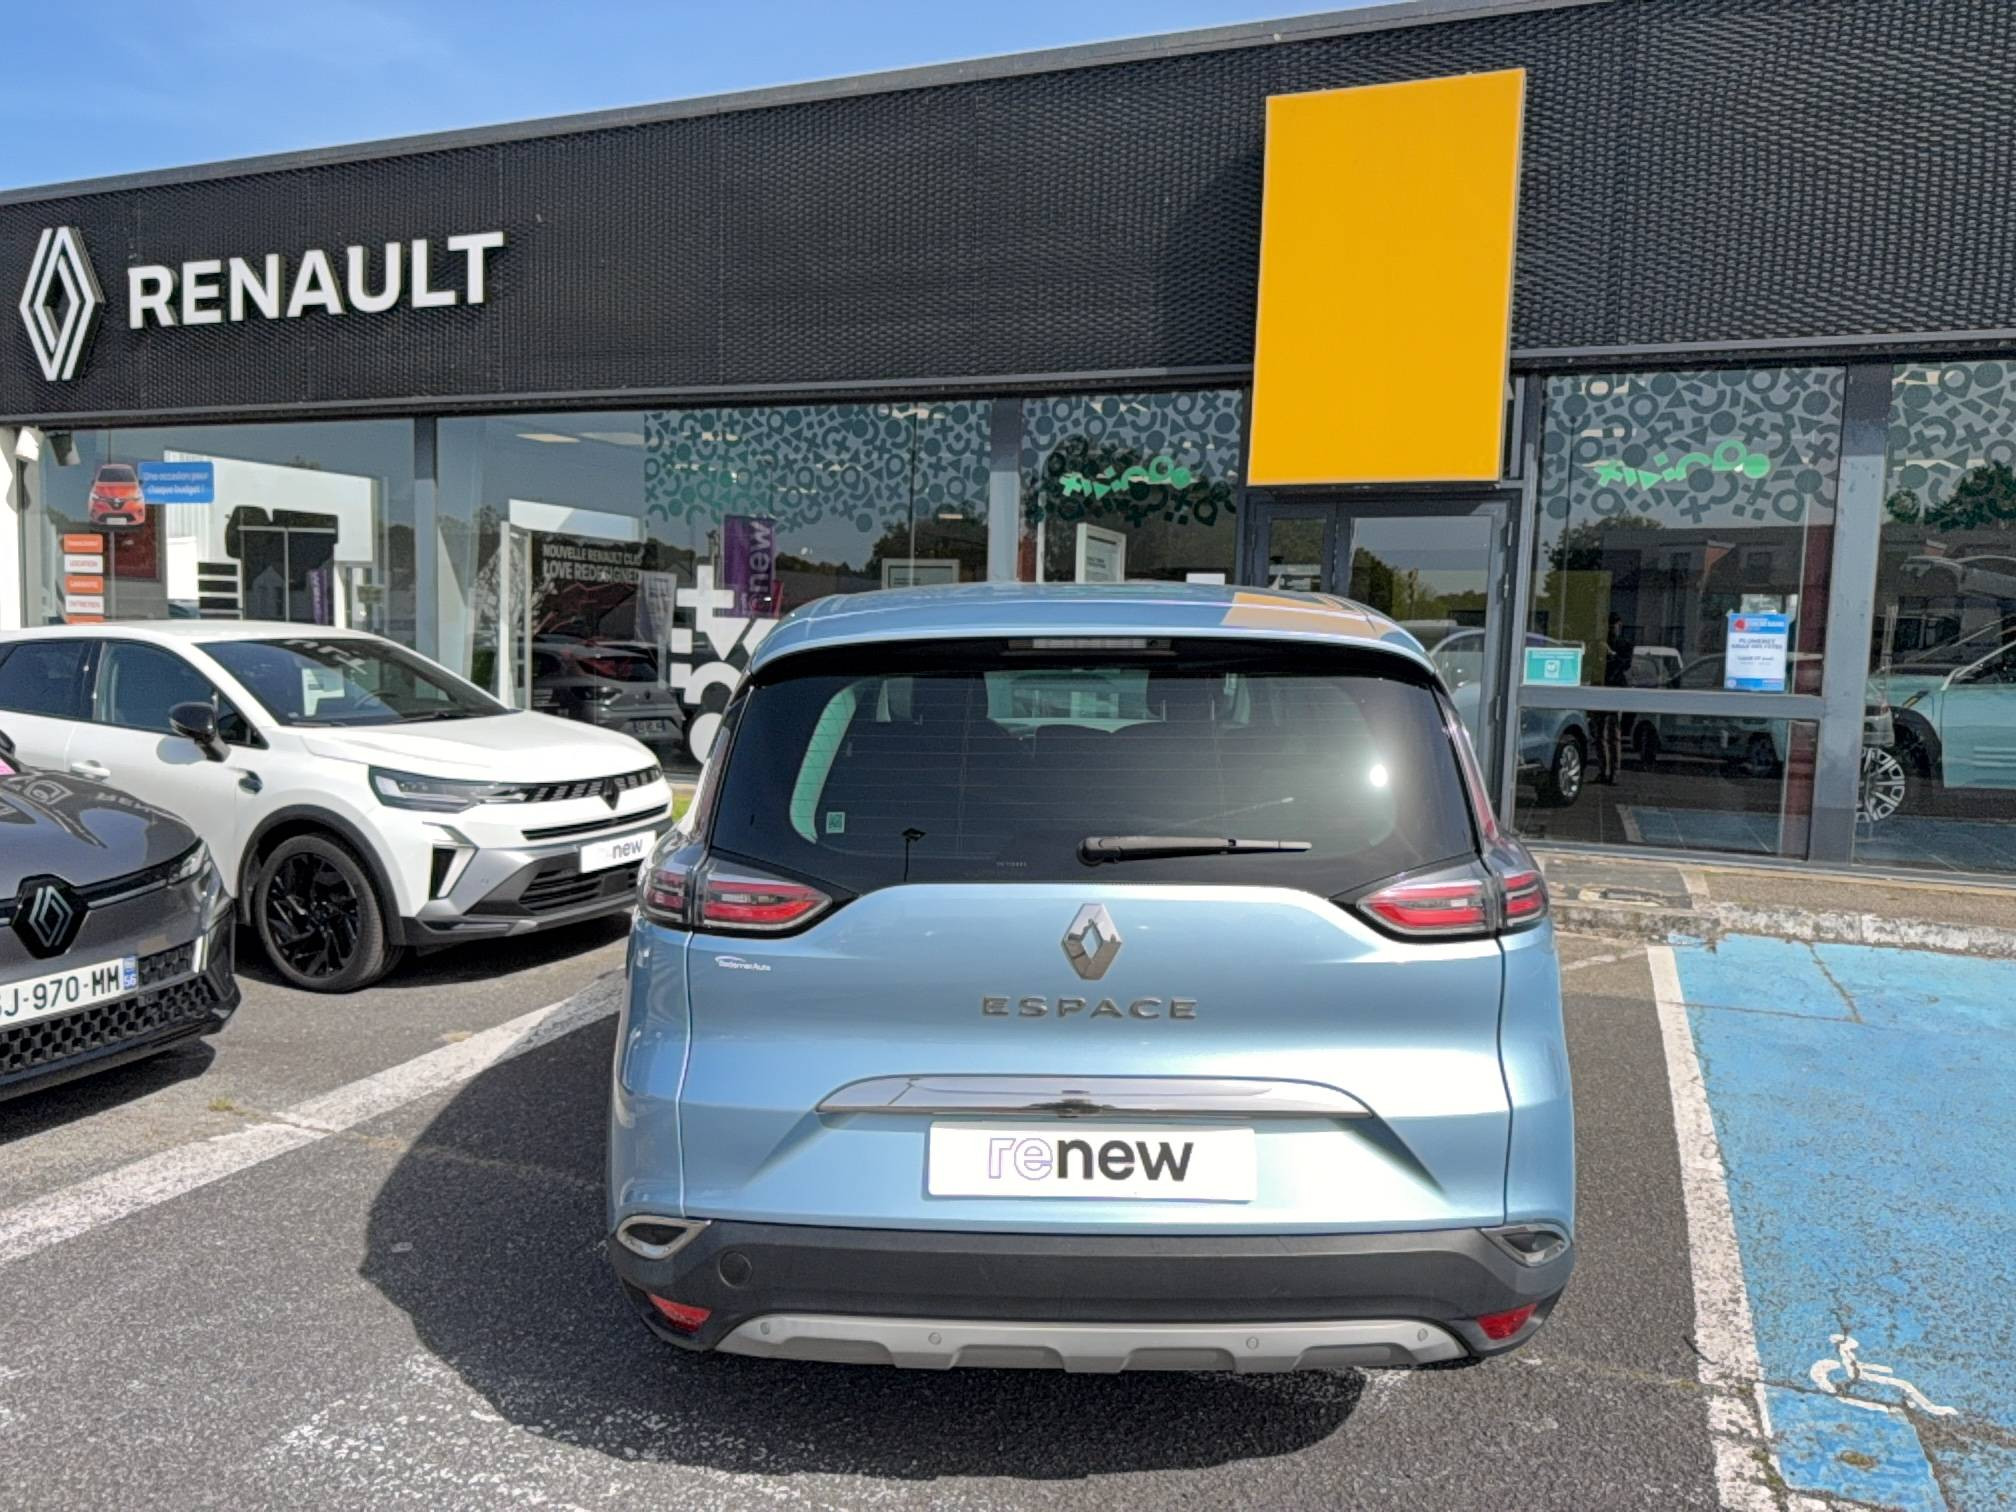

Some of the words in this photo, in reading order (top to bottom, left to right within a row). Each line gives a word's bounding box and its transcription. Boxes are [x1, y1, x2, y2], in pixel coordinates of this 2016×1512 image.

[128, 231, 504, 330] RENAULT
[543, 544, 586, 561] NOUVELLE
[587, 548, 623, 564] RENAULT
[543, 559, 574, 580] LOVE
[0, 965, 120, 1018] J-970-MM
[982, 995, 1198, 1020] ESPACE
[988, 1136, 1195, 1182] renew
